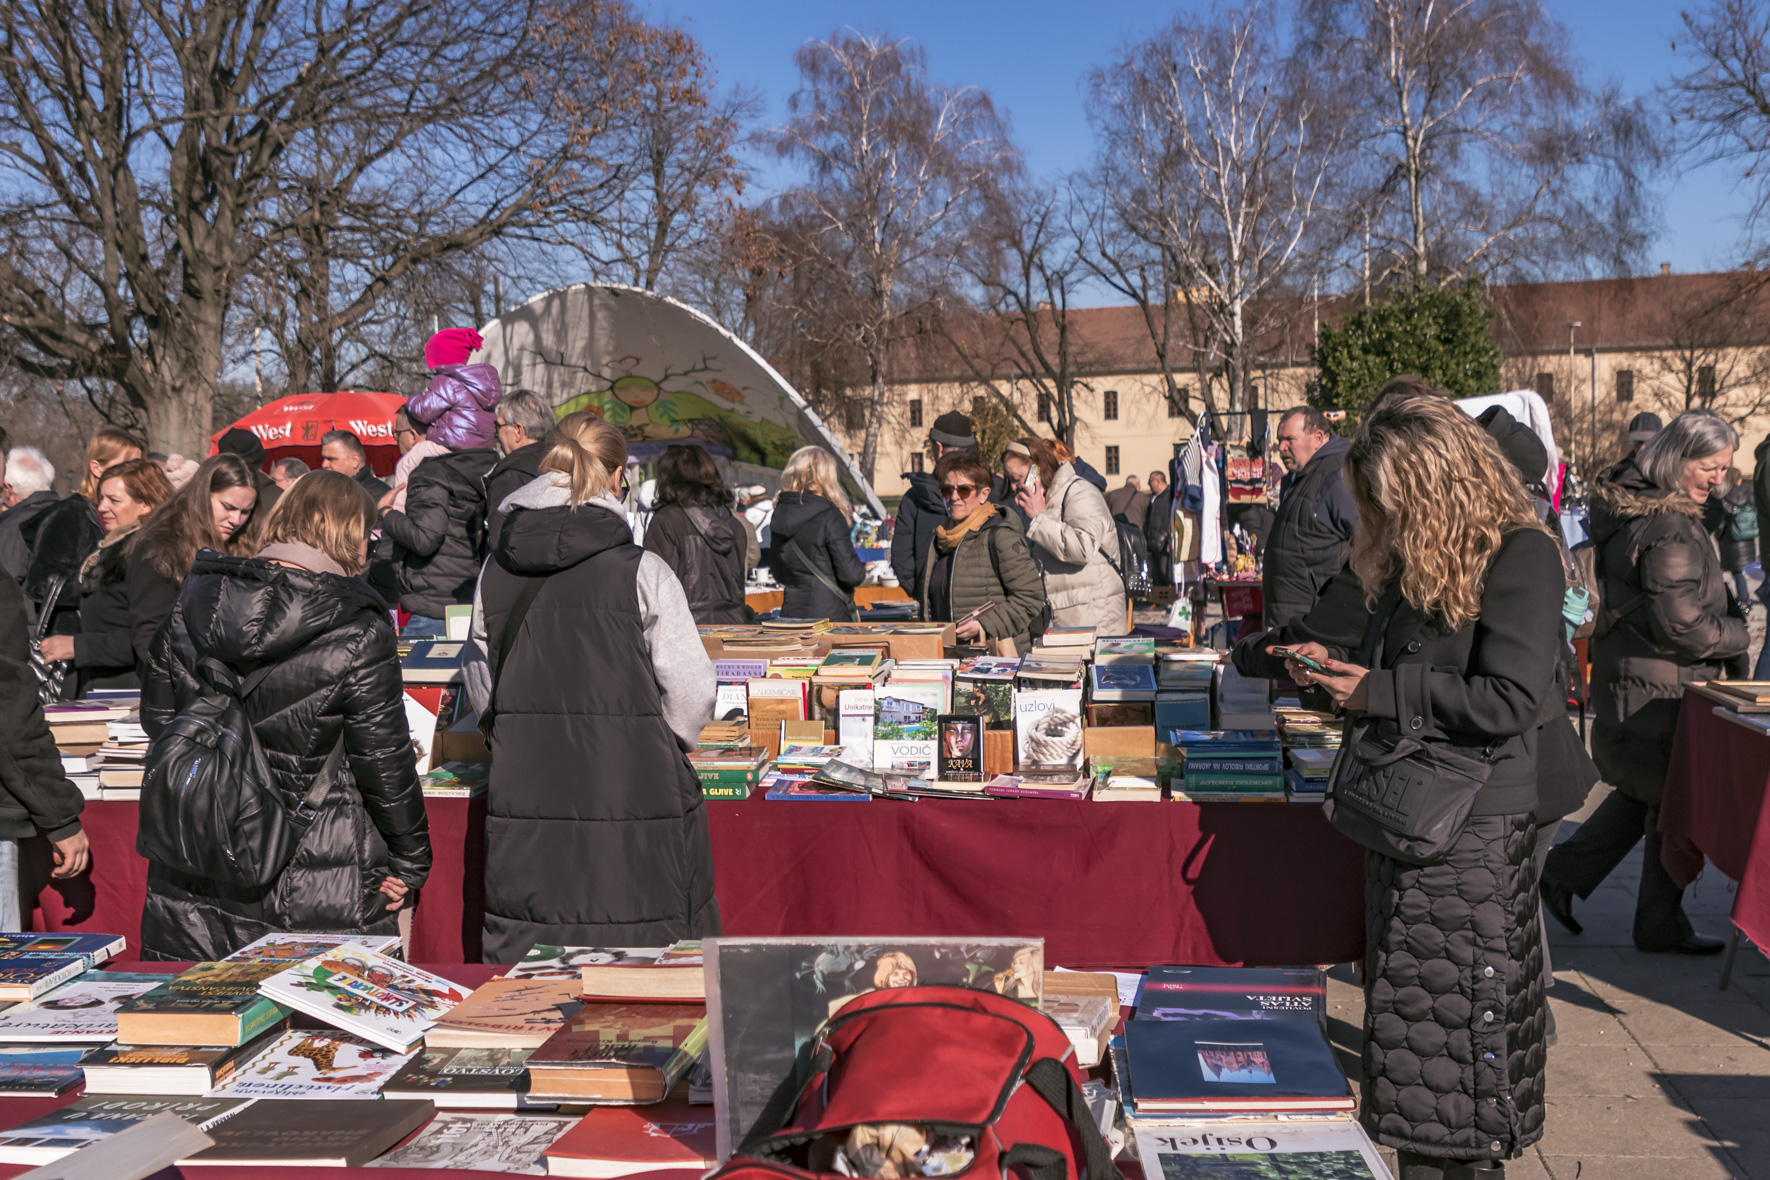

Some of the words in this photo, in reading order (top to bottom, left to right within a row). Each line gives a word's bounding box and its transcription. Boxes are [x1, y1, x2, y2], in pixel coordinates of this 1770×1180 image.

[250, 421, 293, 441] West
[348, 419, 394, 437] West
[756, 688, 797, 696] ALKEMIČAR
[722, 693, 747, 701] DIAN
[1019, 698, 1056, 712] uzlovi
[891, 744, 932, 756] VODIČ
[947, 758, 973, 769] KAVA
[1188, 762, 1212, 770] JADRANU
[1245, 763, 1270, 771] SPORTSKI
[698, 772, 720, 780] JIVE
[709, 788, 734, 796] GLJIVE
[168, 985, 257, 993] OVJEČANSTVA
[333, 974, 410, 1009] SLIKOTVORINE
[0, 1021, 118, 1031] arikature
[107, 1056, 190, 1064] BIBLIJSKI
[236, 1081, 356, 1093] plastelinom
[231, 1089, 307, 1097] oblikovanje
[87, 1101, 221, 1111] PRIRODI
[62, 1111, 88, 1120] U
[89, 1112, 200, 1121] ISRANA
[1154, 1133, 1278, 1152] Osijek
